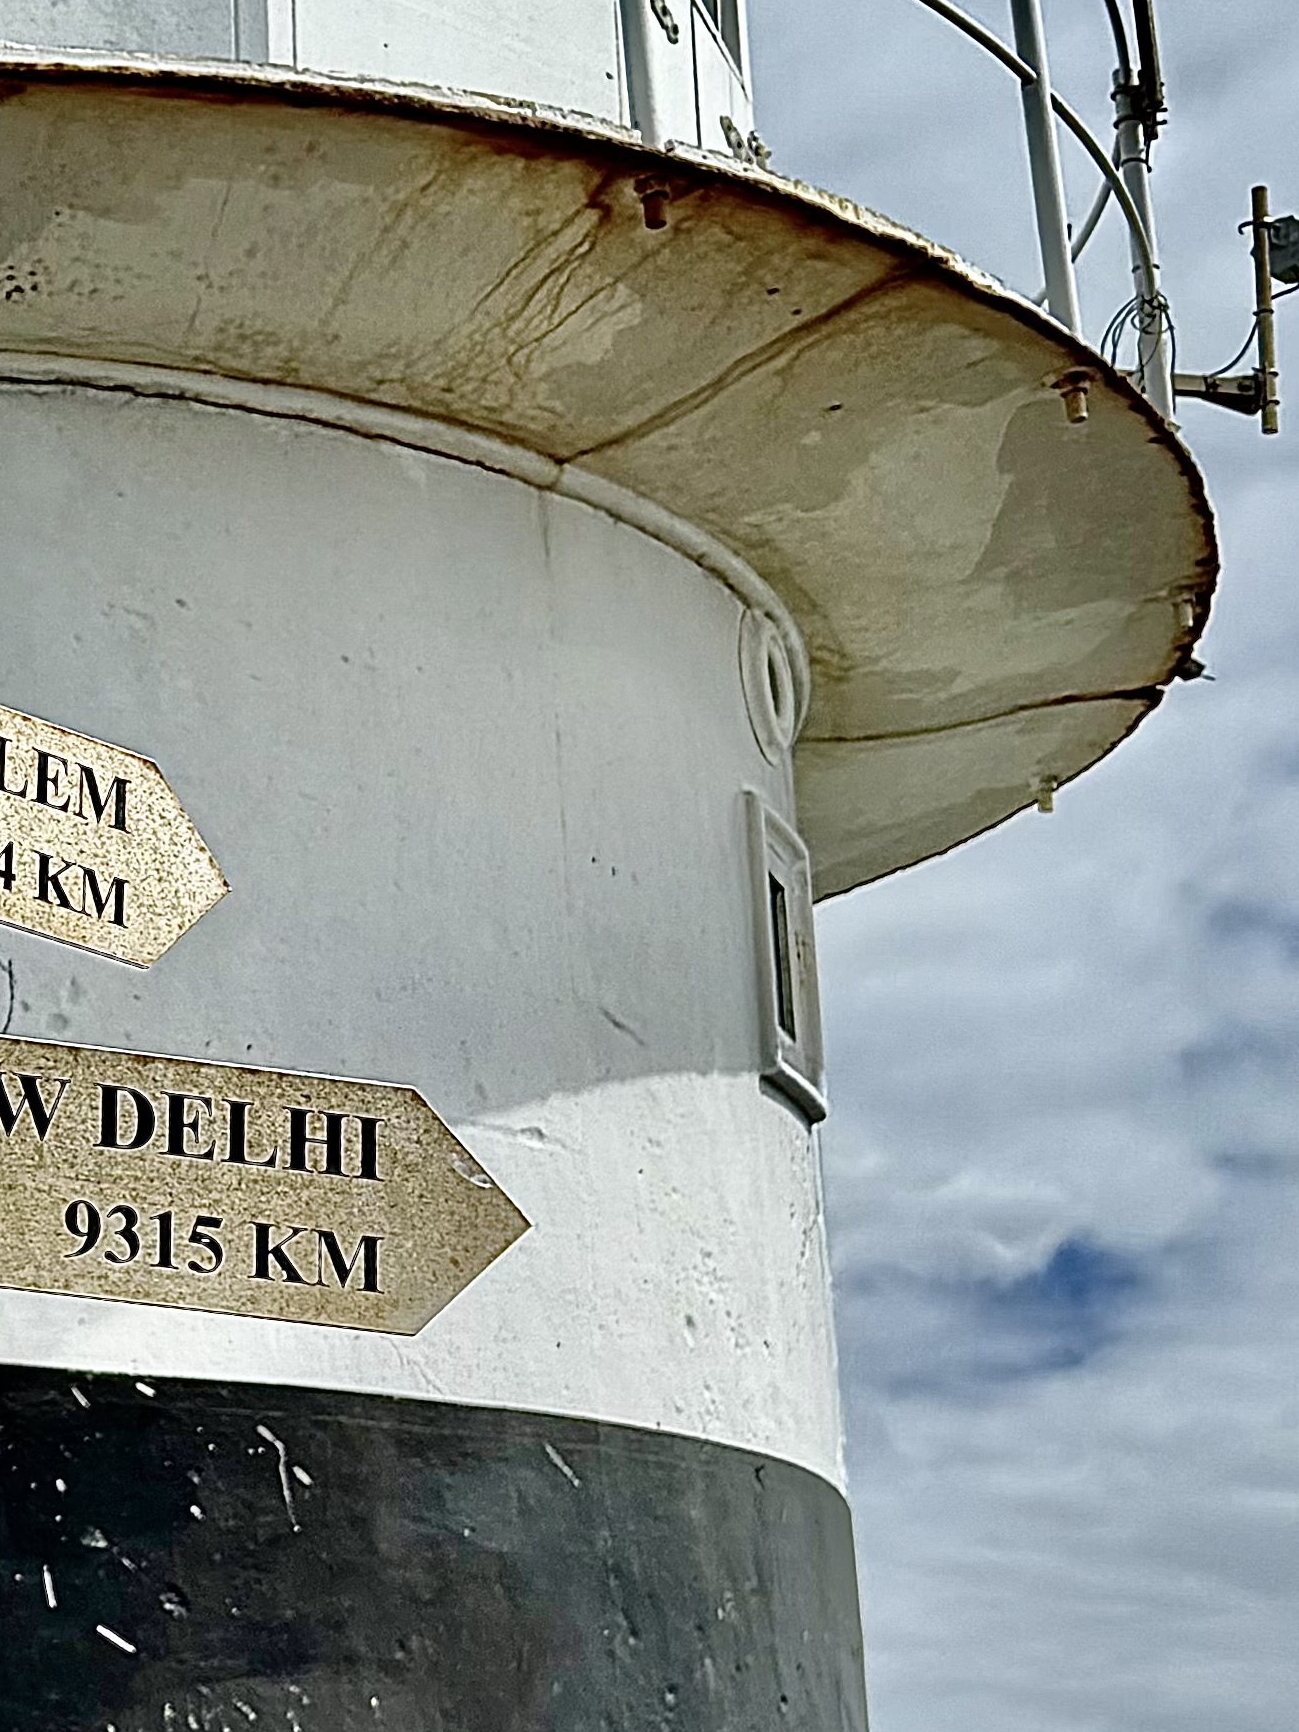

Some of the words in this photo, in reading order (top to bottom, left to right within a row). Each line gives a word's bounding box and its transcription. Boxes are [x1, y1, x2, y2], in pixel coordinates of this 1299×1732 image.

[31, 849, 130, 928] KM
[93, 1081, 387, 1183] DELHI
[63, 1198, 226, 1275] 9315
[248, 1221, 386, 1295] KM
